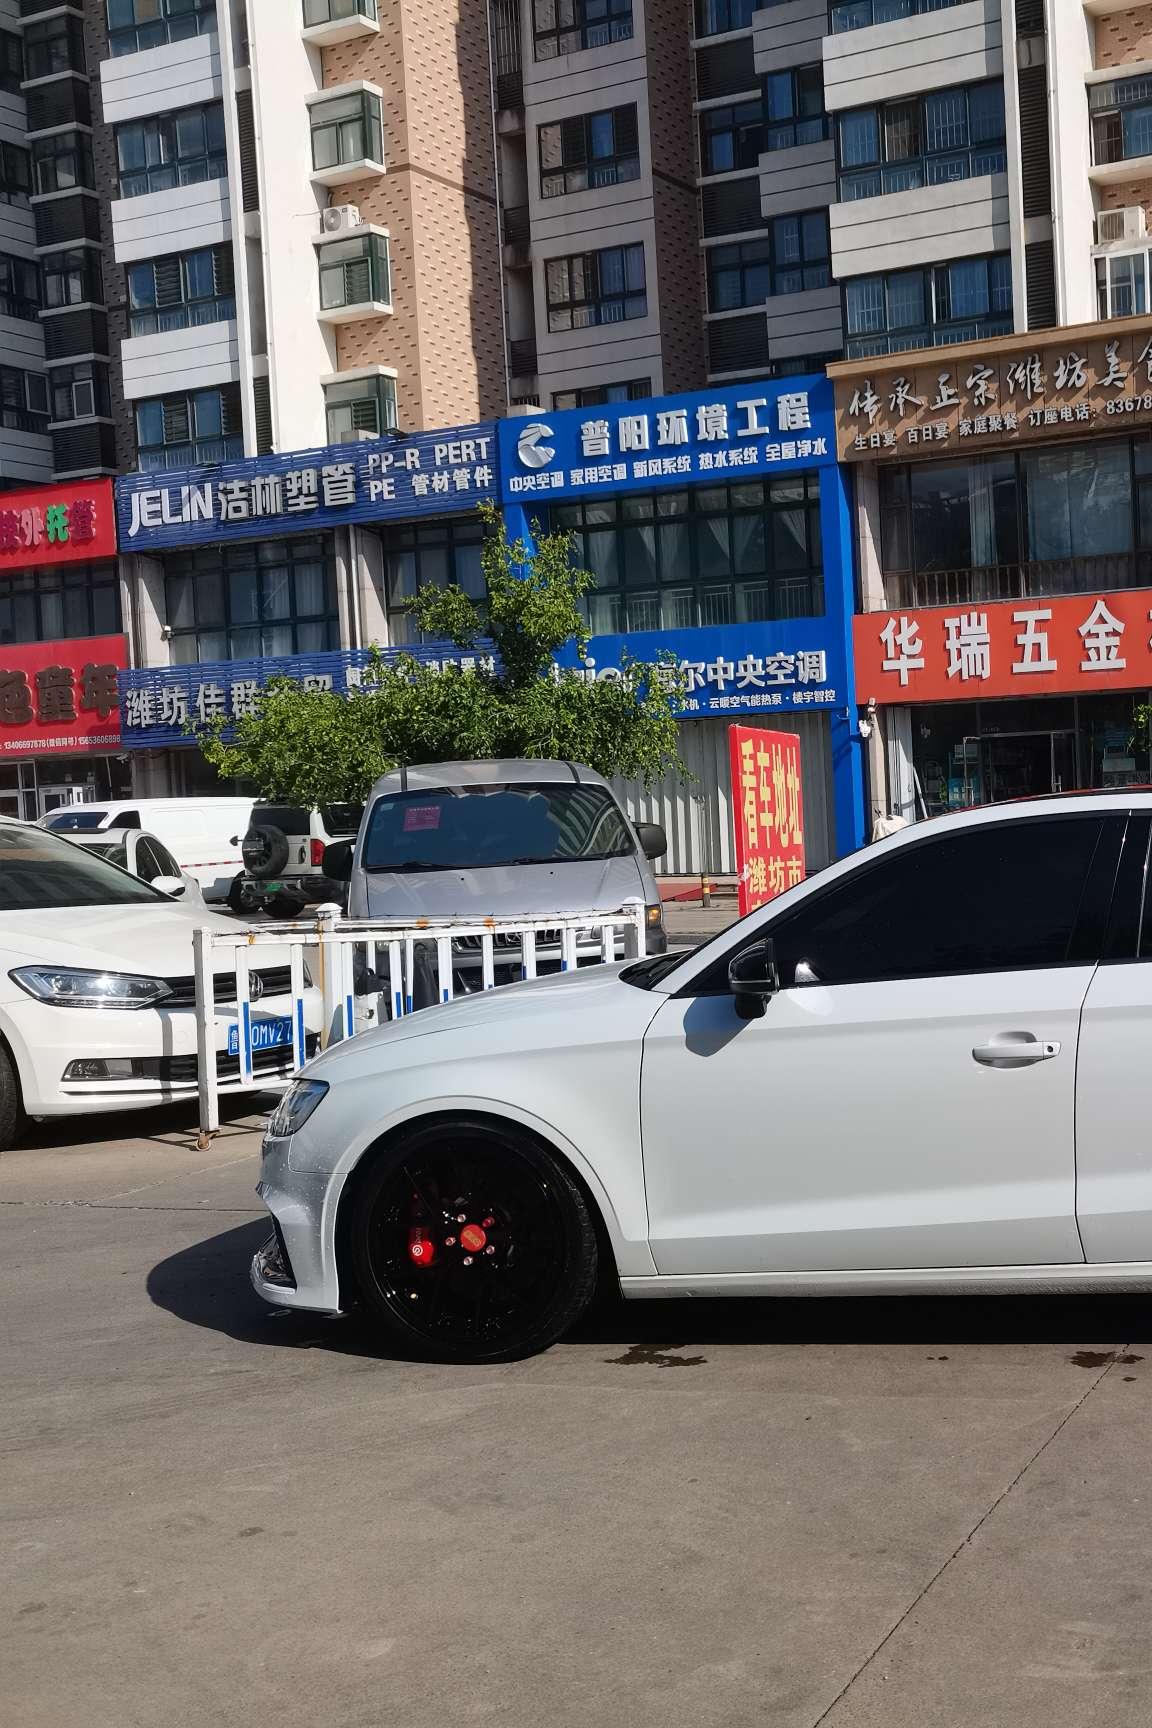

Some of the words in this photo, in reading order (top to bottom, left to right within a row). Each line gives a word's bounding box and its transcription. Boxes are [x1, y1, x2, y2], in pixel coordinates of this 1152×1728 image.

[580, 391, 812, 458] 普阳环境工程
[854, 429, 897, 451] 生日宴
[906, 422, 950, 444] 百日宴
[959, 411, 1019, 437] 家庭聚餐
[367, 447, 421, 475] PP-R
[434, 437, 491, 466] PERT
[509, 470, 565, 493] 中央空调
[570, 463, 627, 486] 家用空调
[633, 455, 692, 479] 新风系统
[698, 447, 759, 471] 热水系统
[765, 437, 828, 463] 全屋净水
[127, 482, 213, 538] JELIN
[218, 462, 357, 521] 洁林塑管
[369, 477, 396, 502] PE
[411, 464, 493, 497] 管材管件
